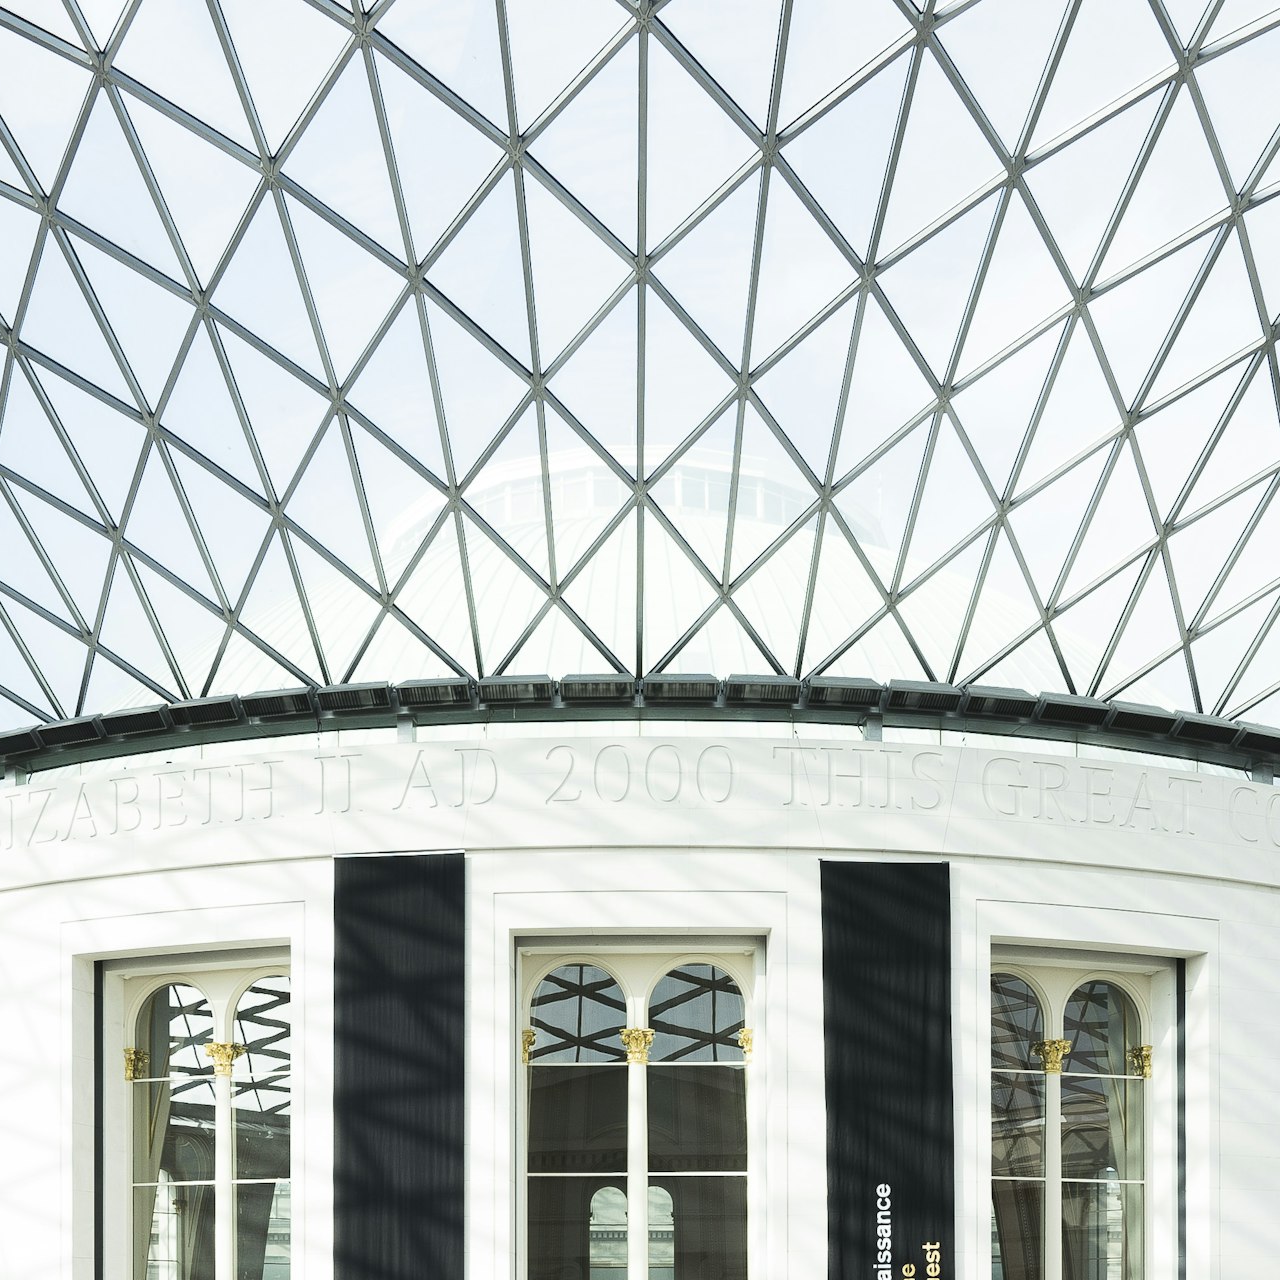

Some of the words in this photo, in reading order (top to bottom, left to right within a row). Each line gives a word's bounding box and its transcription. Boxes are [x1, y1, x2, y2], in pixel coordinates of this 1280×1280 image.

[314, 754, 364, 815] II
[392, 746, 499, 811] AD
[545, 744, 734, 804] 2000
[772, 745, 943, 811] THIS
[981, 754, 1202, 835] GREAT
